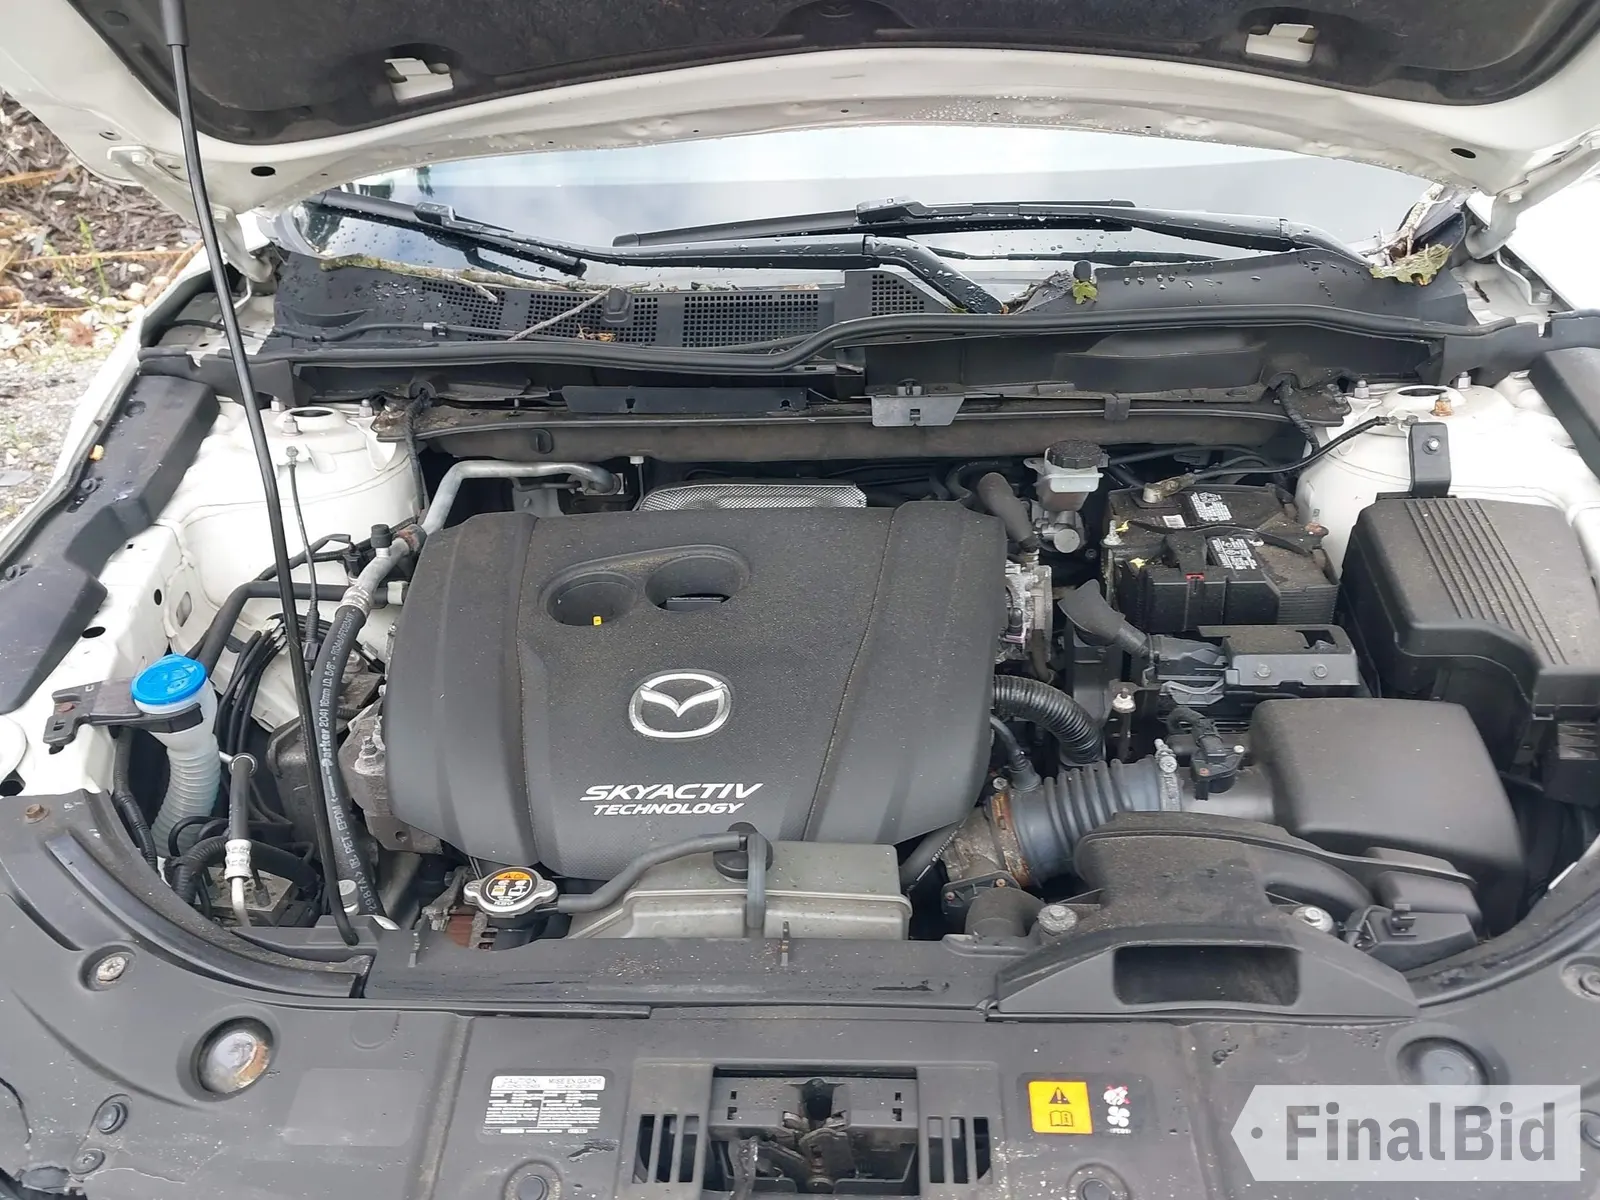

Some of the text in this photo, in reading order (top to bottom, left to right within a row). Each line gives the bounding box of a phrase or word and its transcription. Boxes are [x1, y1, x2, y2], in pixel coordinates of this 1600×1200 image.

[319, 708, 330, 728] 2041
[320, 728, 334, 769] Parker
[580, 783, 764, 801] SKYACTIV
[593, 803, 745, 816] TECHNOLOGY
